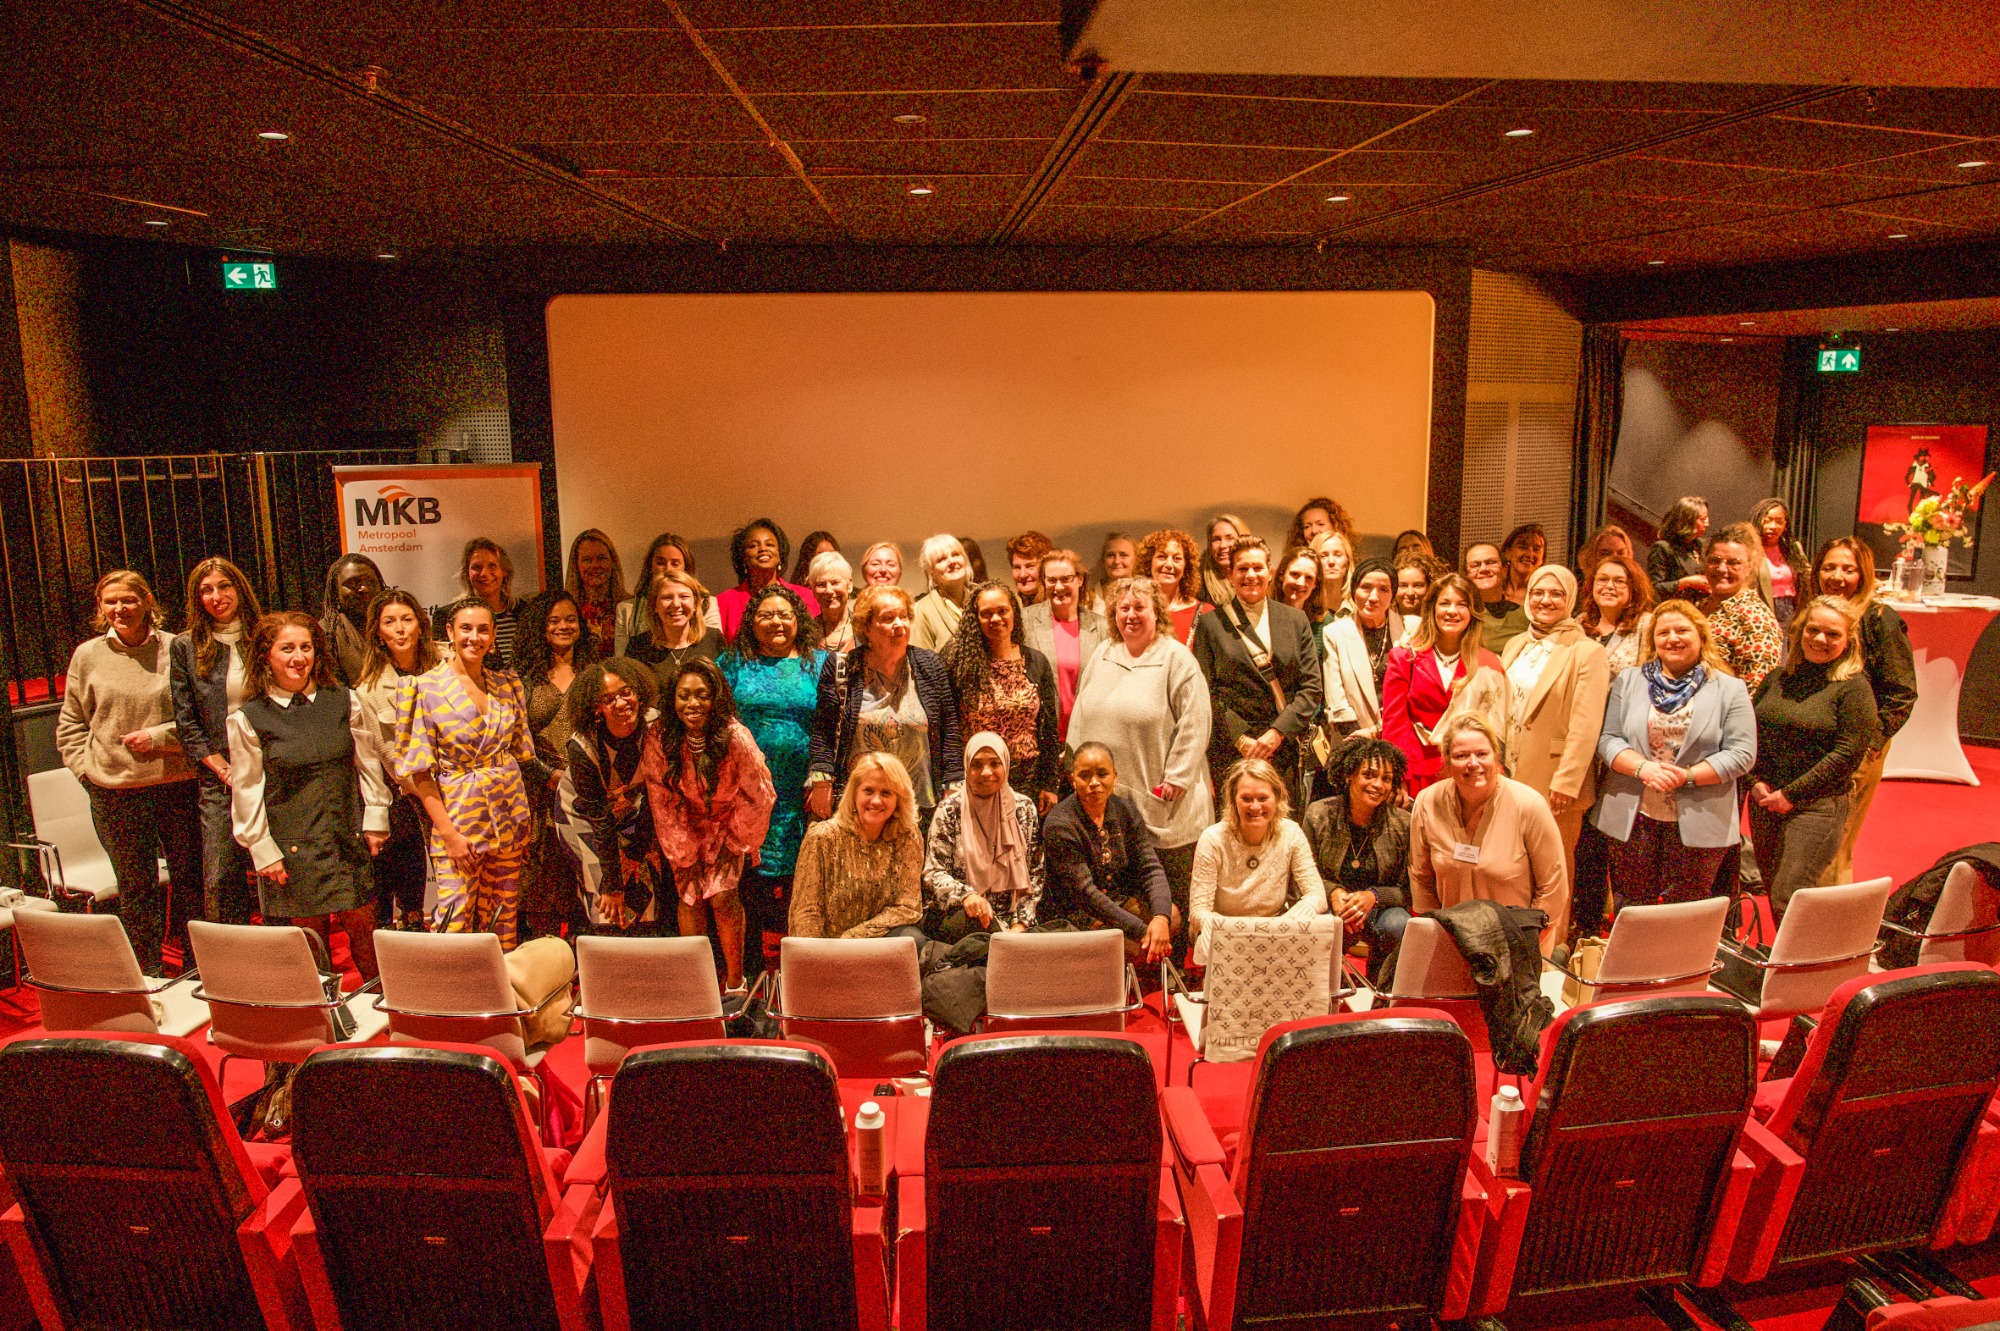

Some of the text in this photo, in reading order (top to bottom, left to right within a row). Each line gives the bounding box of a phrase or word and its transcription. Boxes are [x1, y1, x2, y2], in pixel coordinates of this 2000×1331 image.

[355, 497, 442, 526] MKB
[358, 529, 416, 540] Metropool
[359, 542, 423, 553] Amsterdam
[1209, 1035, 1262, 1047] VUITTO
